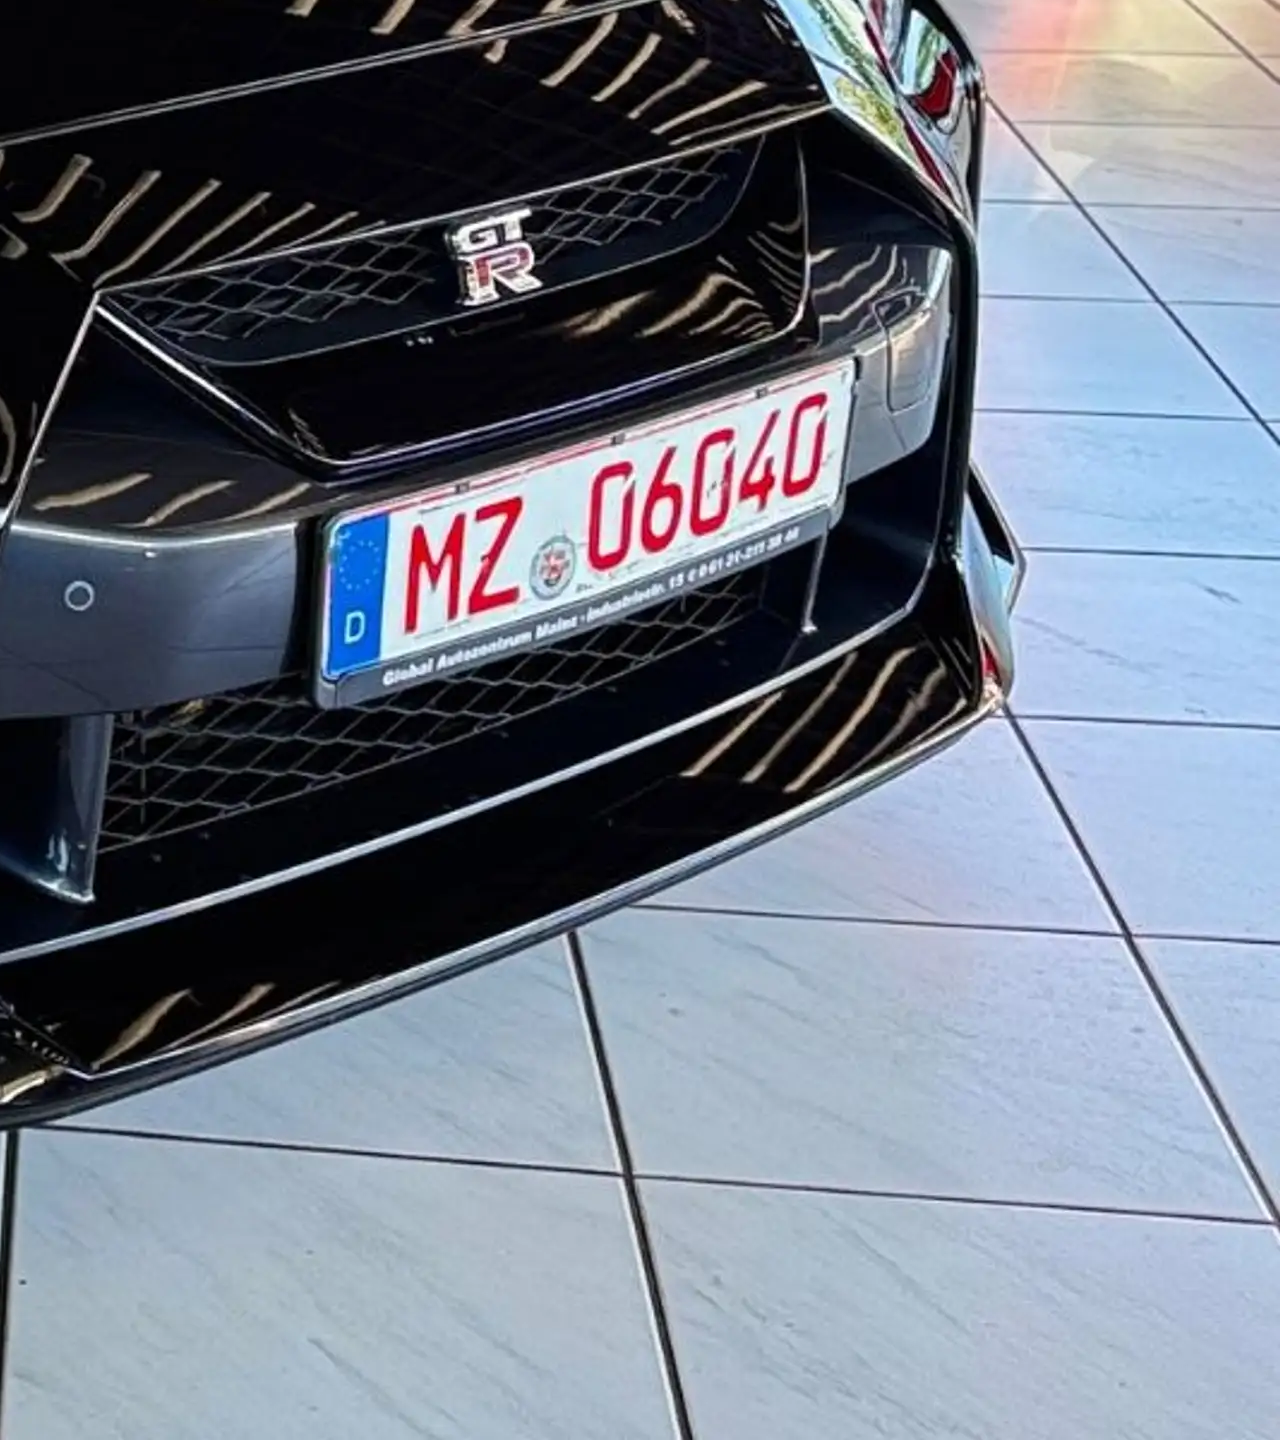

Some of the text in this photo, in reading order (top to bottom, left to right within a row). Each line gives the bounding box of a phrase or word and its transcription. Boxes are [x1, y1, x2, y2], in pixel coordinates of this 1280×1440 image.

[405, 392, 828, 633] MZ 06040
[344, 611, 366, 644] D
